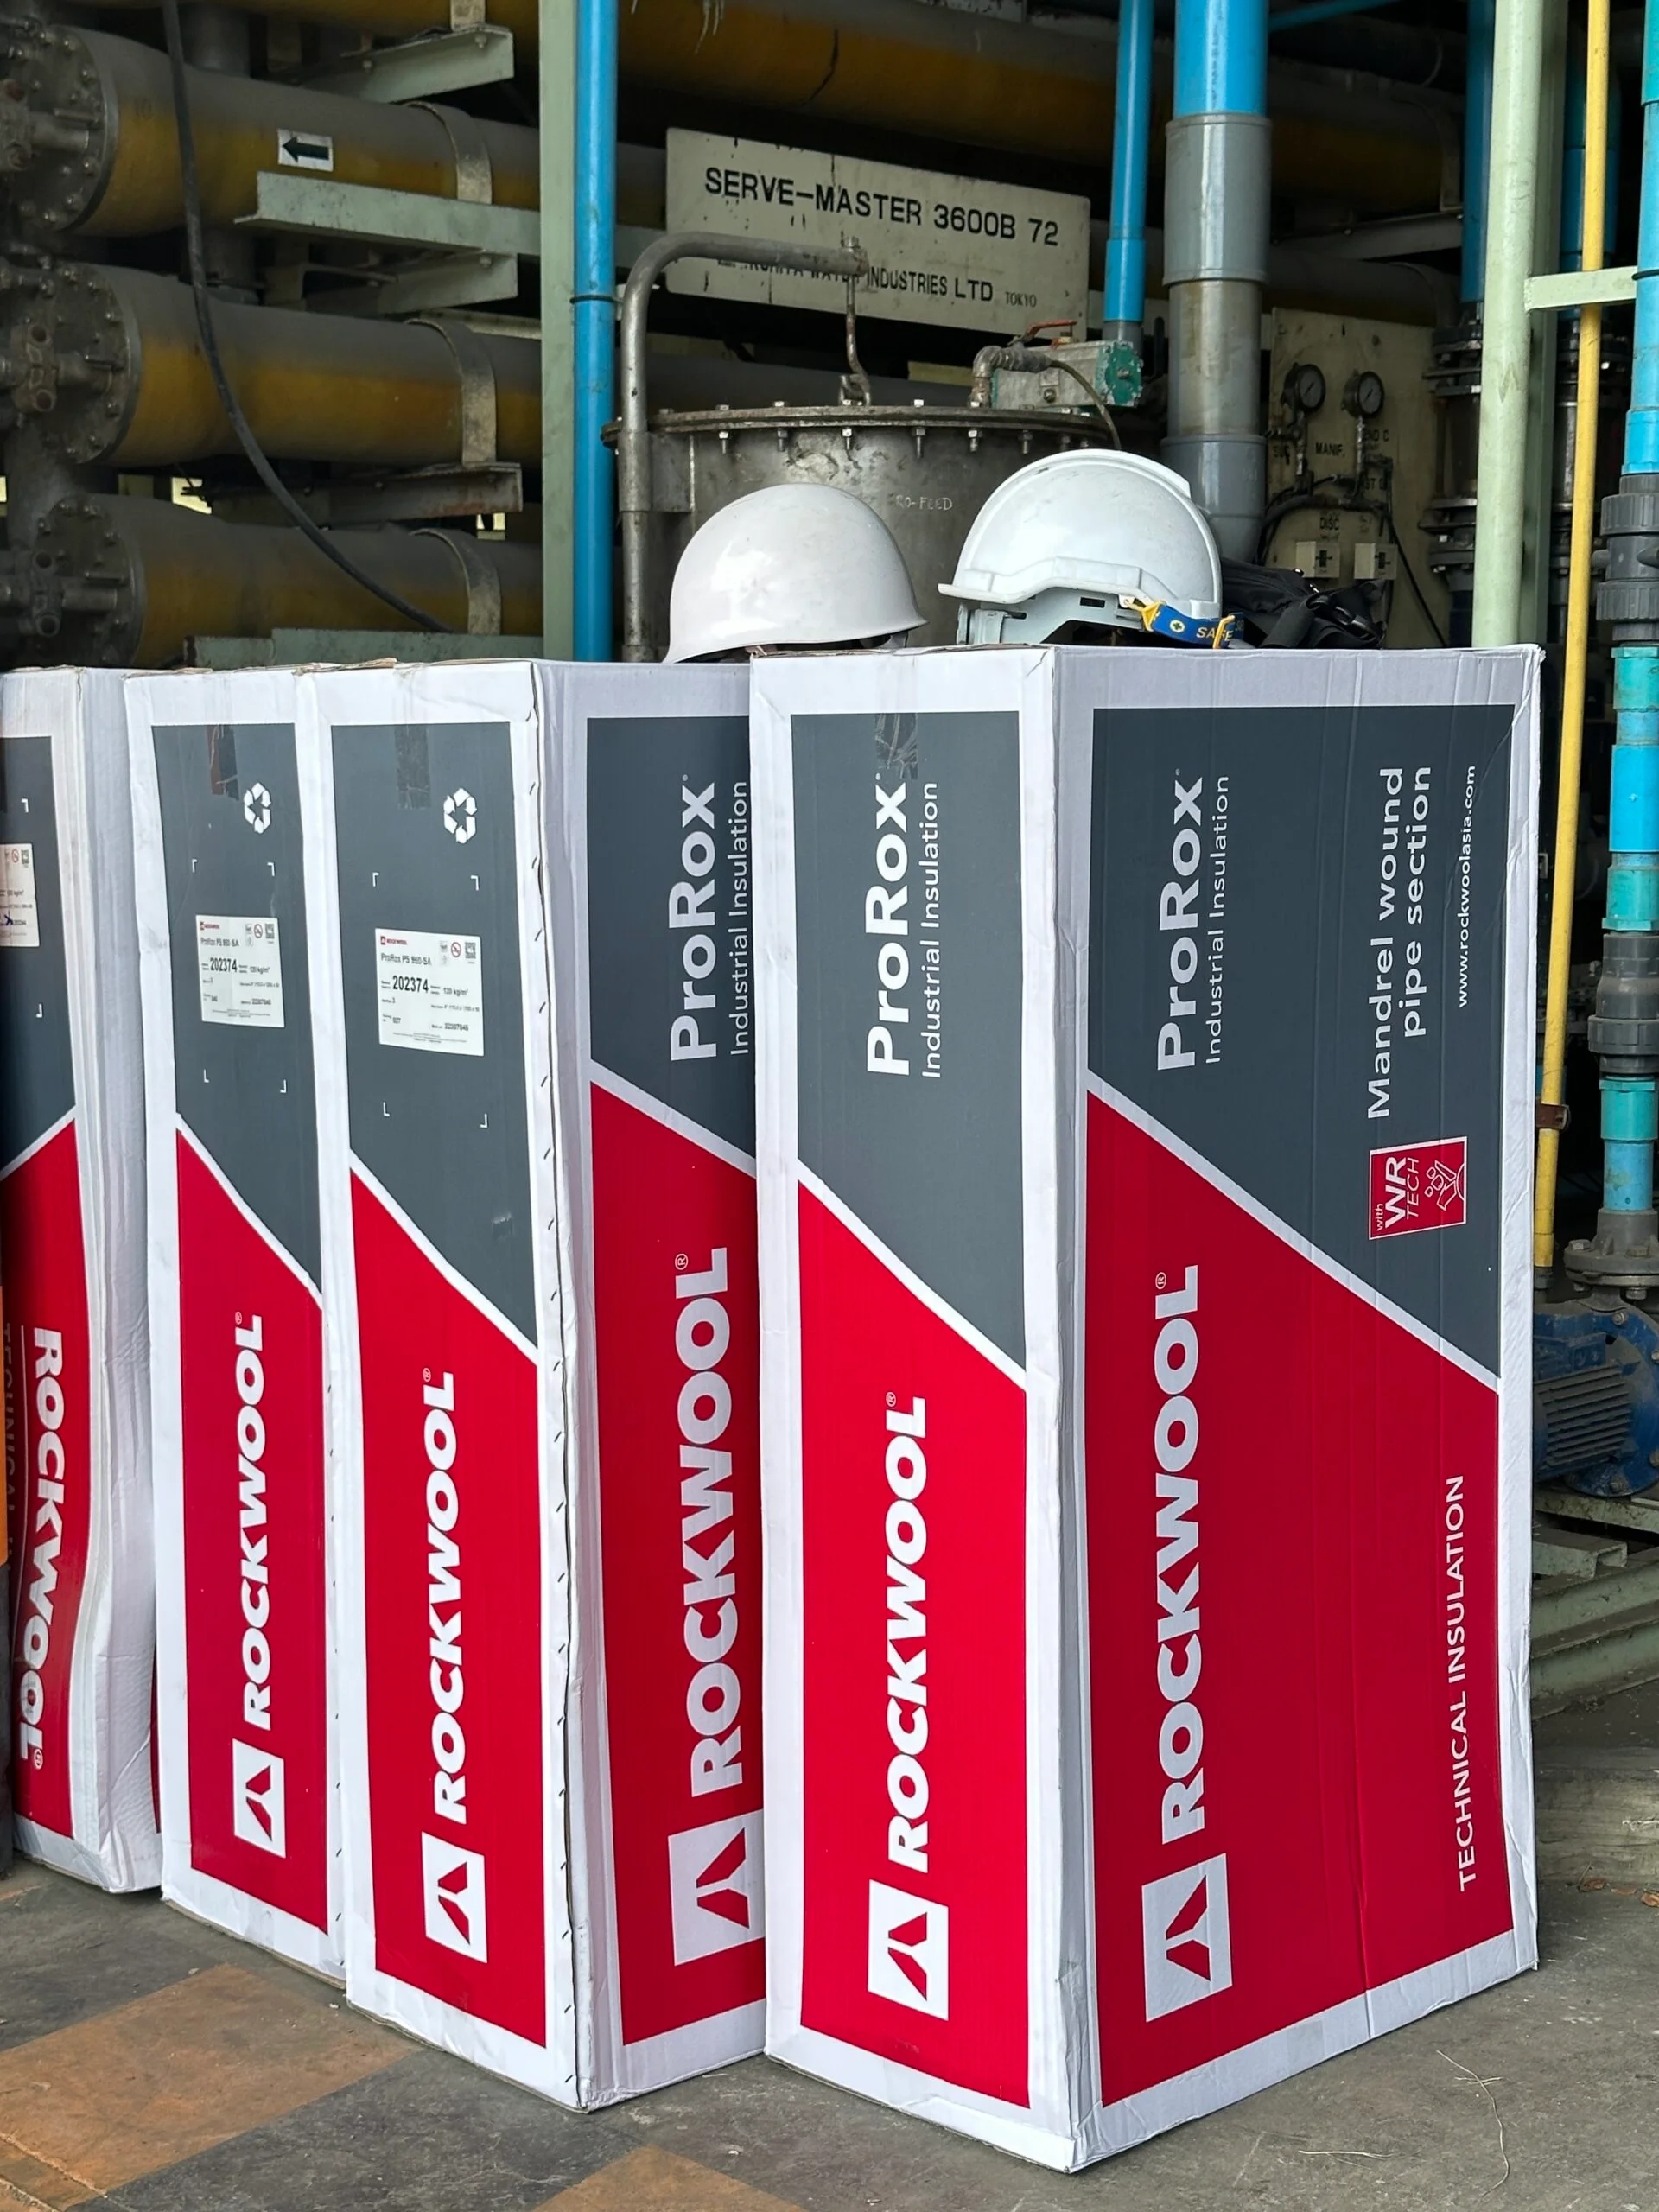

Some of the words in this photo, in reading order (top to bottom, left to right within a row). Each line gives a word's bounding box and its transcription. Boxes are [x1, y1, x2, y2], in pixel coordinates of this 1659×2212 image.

[705, 167, 922, 226] SERVE-MASTER
[933, 204, 1016, 239] 3600B
[1027, 218, 1059, 247] 72
[867, 266, 948, 296] INDUSTRIES
[955, 279, 994, 302] LTD
[1005, 291, 1038, 308] TOKYO
[1315, 442, 1345, 458] MANIF.
[1196, 626, 1233, 642] SAE
[727, 781, 748, 916] Insulation
[918, 783, 940, 928] Insulation
[1209, 776, 1229, 918] Insulation
[1379, 767, 1403, 922] wound
[1405, 766, 1431, 925] section
[1458, 766, 1476, 1007] www.rockwoolasia.com
[210, 957, 238, 973] 202374
[392, 975, 429, 994] 202374
[728, 927, 749, 1056] Industrial
[919, 940, 941, 1078] Industrial
[1205, 929, 1224, 1064] Industrial
[1368, 937, 1394, 1119] Mandrel
[1398, 940, 1427, 1038] pipe
[1375, 1203, 1384, 1231] with
[1385, 1156, 1407, 1229] WR
[1407, 1157, 1420, 1220] TECH
[1446, 1475, 1465, 1684] INSULATION
[1451, 1690, 1477, 1892] TECHNICAL
